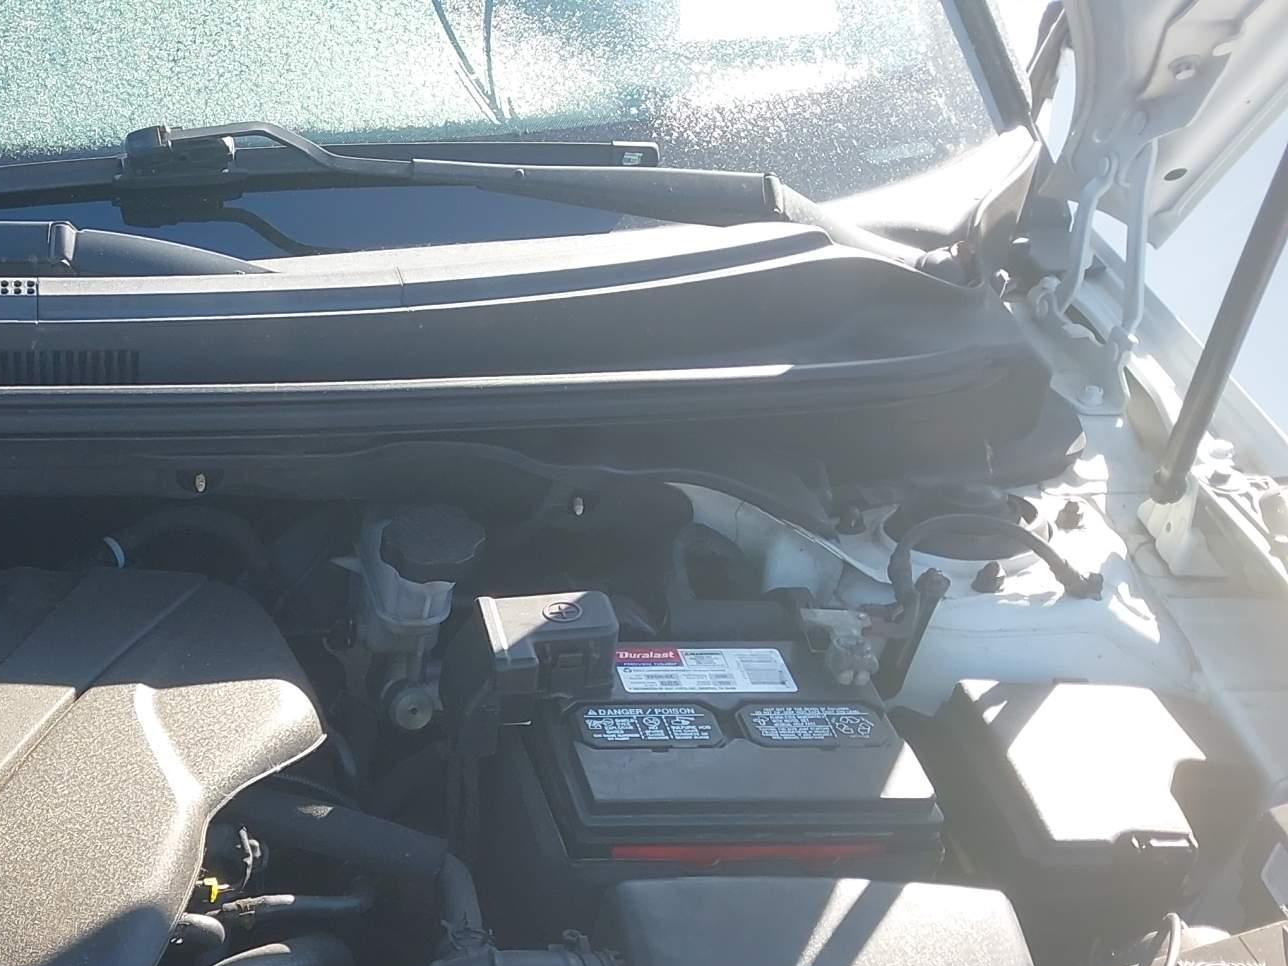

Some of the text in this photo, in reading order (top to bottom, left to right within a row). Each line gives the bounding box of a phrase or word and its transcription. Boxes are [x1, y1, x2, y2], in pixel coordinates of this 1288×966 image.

[616, 651, 675, 659] Duralast
[598, 708, 643, 716] DANGER
[654, 707, 695, 715] POISON
